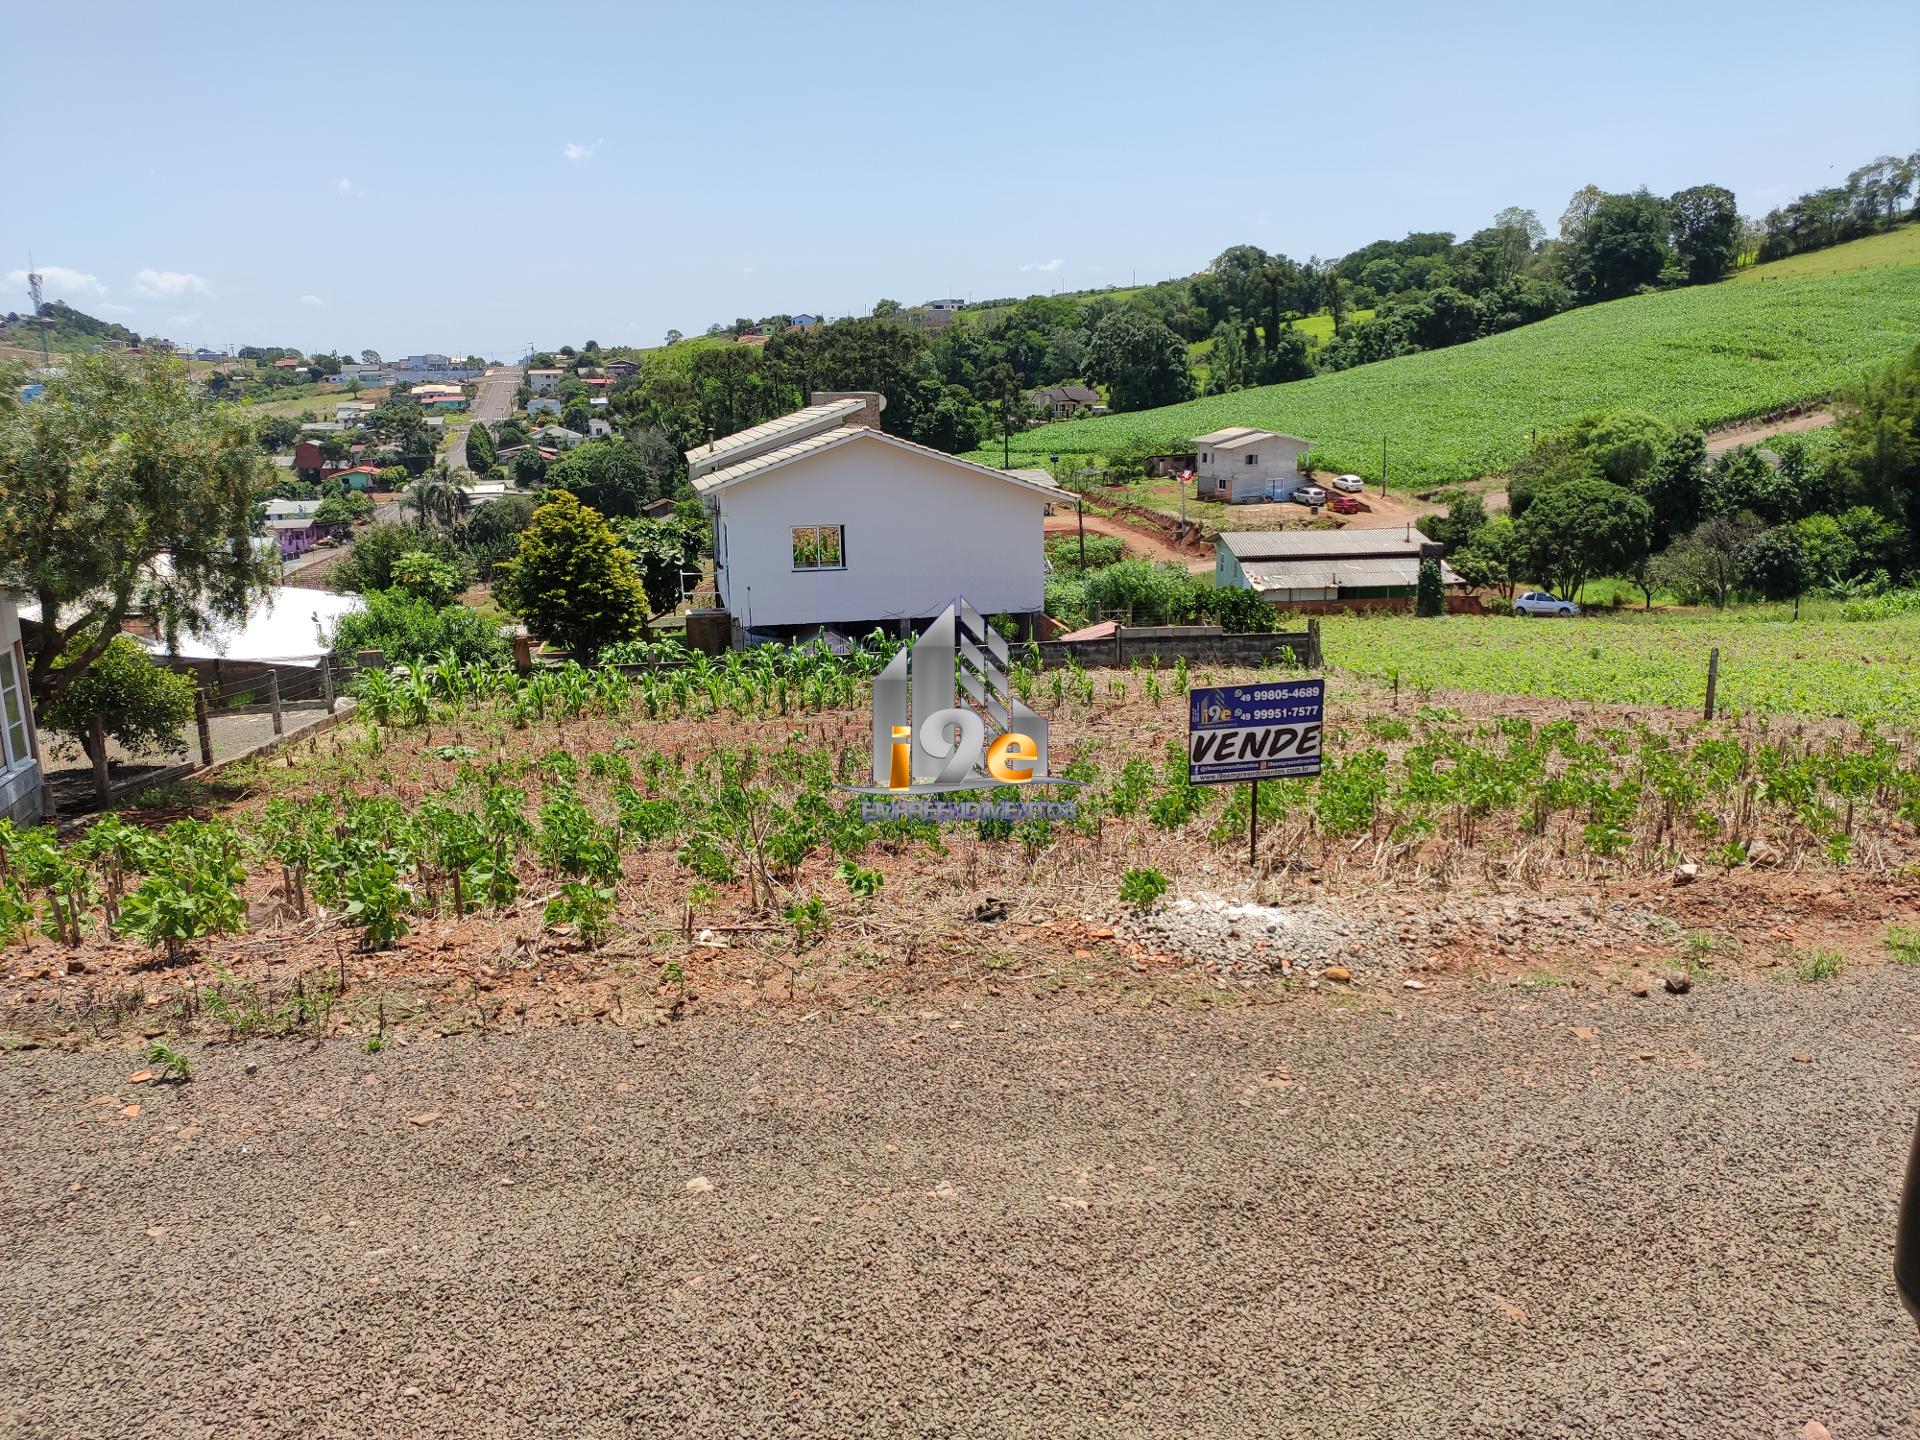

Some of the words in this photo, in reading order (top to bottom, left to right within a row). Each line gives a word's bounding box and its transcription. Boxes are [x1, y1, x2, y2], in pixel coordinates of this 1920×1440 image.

[1240, 694, 1251, 702] 49
[1253, 687, 1320, 701] 99805-4689
[1240, 712, 1251, 721] 49
[1253, 705, 1319, 720] 99951-7577
[1192, 725, 1320, 763] VENDE
